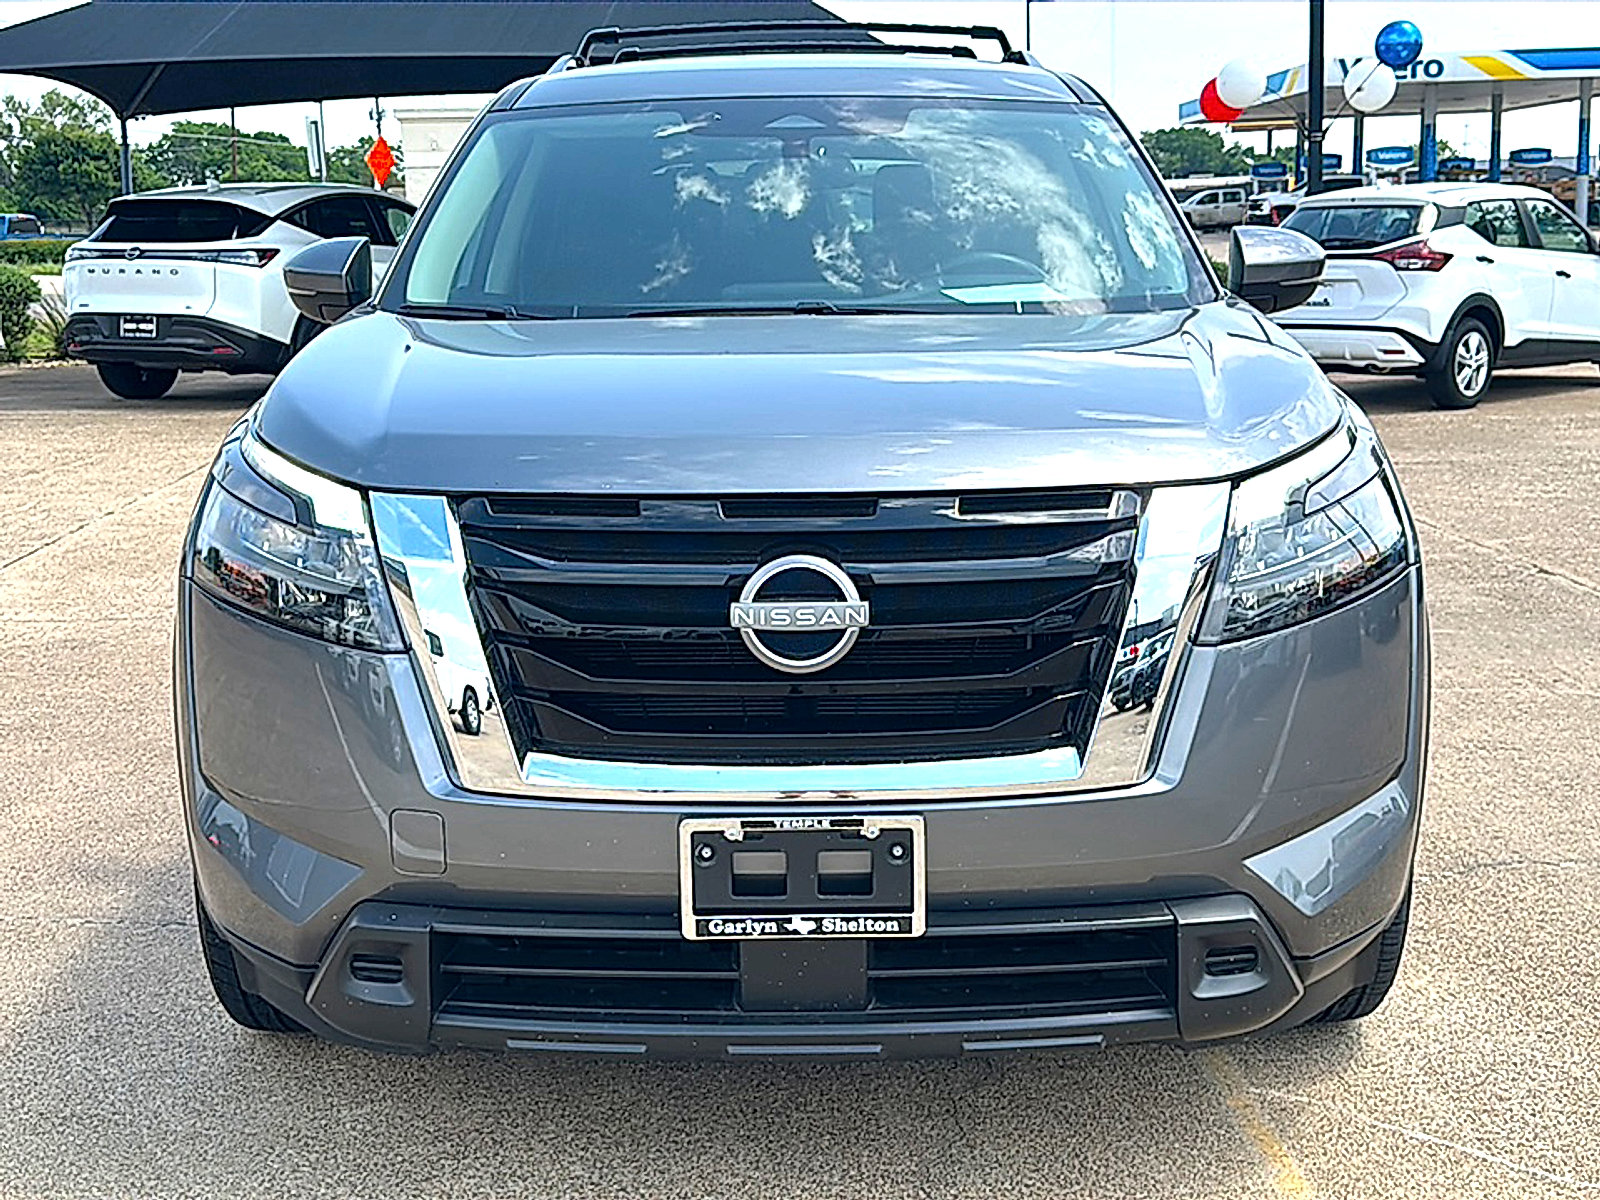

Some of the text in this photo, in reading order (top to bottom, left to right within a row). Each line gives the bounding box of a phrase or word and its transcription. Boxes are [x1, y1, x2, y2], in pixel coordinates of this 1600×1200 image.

[87, 268, 180, 276] MURANO
[733, 606, 866, 626] NISSAN
[774, 819, 832, 829] TEMPLE
[708, 917, 900, 936] Garlyn Shelton
